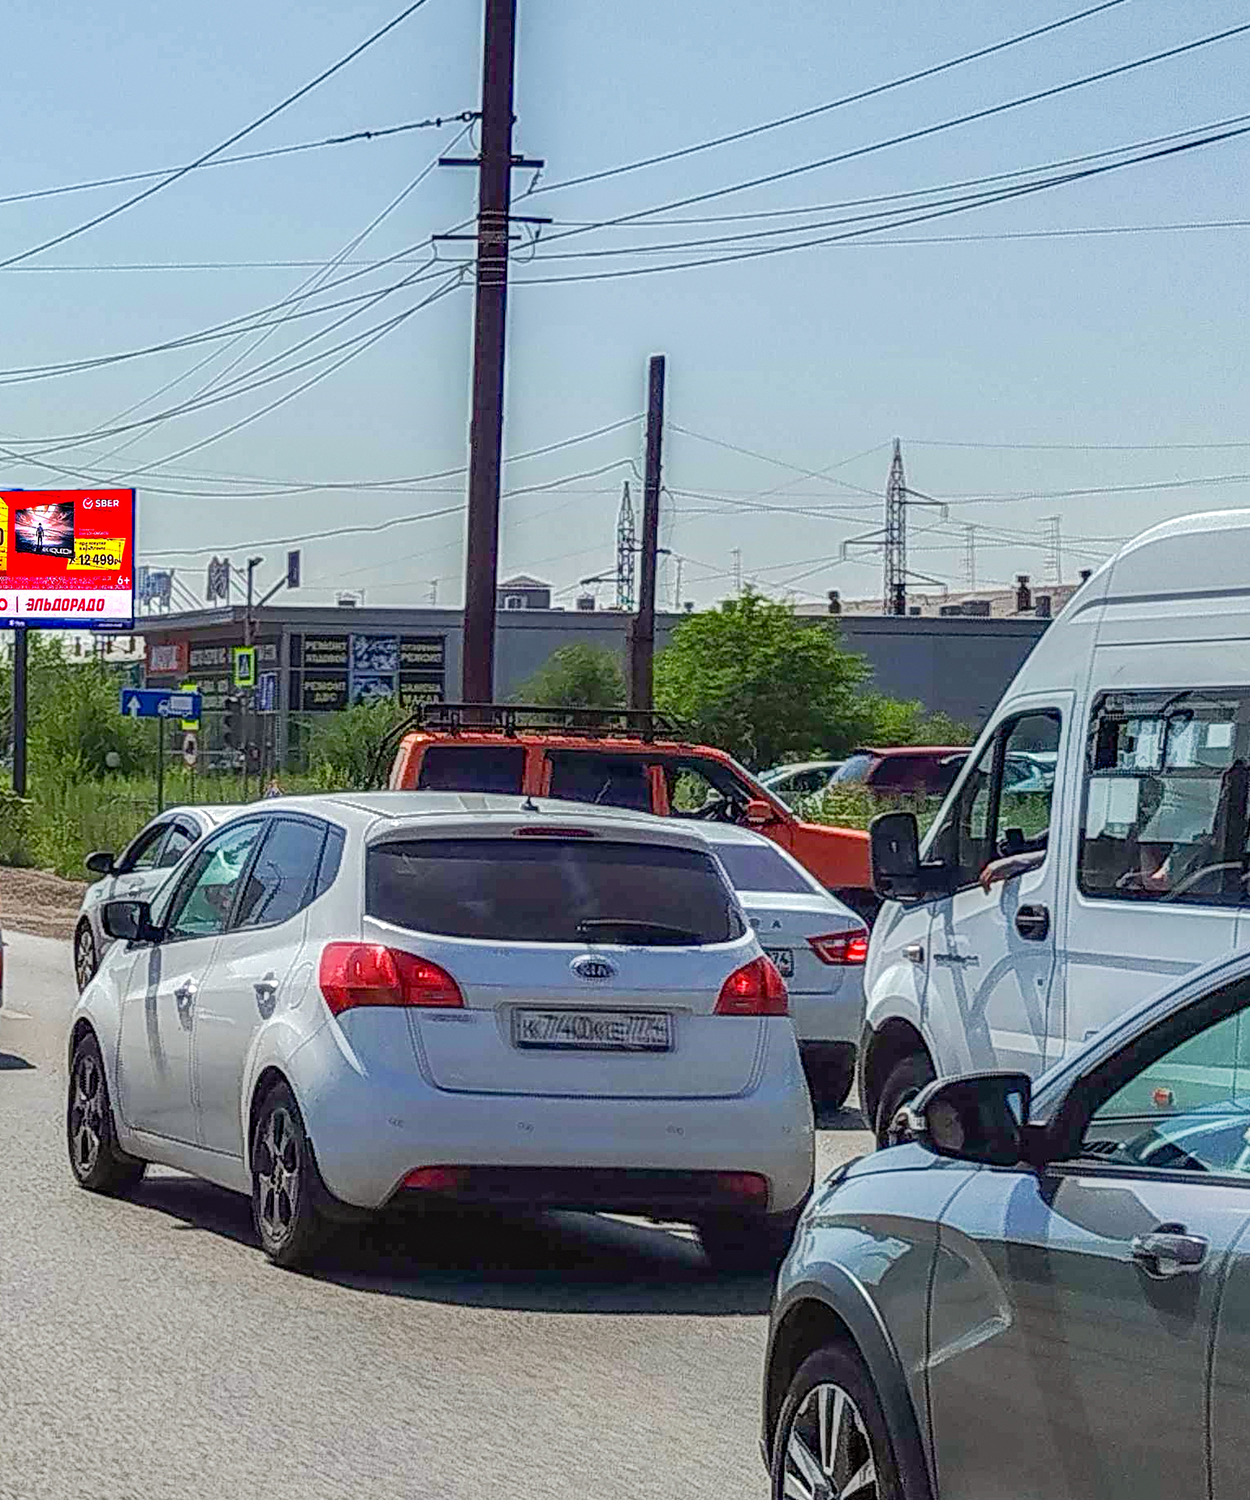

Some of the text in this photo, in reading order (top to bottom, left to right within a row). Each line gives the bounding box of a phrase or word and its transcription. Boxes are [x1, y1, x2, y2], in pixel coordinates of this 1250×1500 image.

[95, 499, 120, 508] SBER
[117, 576, 130, 585] 6+
[26, 598, 105, 612] ЭЛЬДОРАДО
